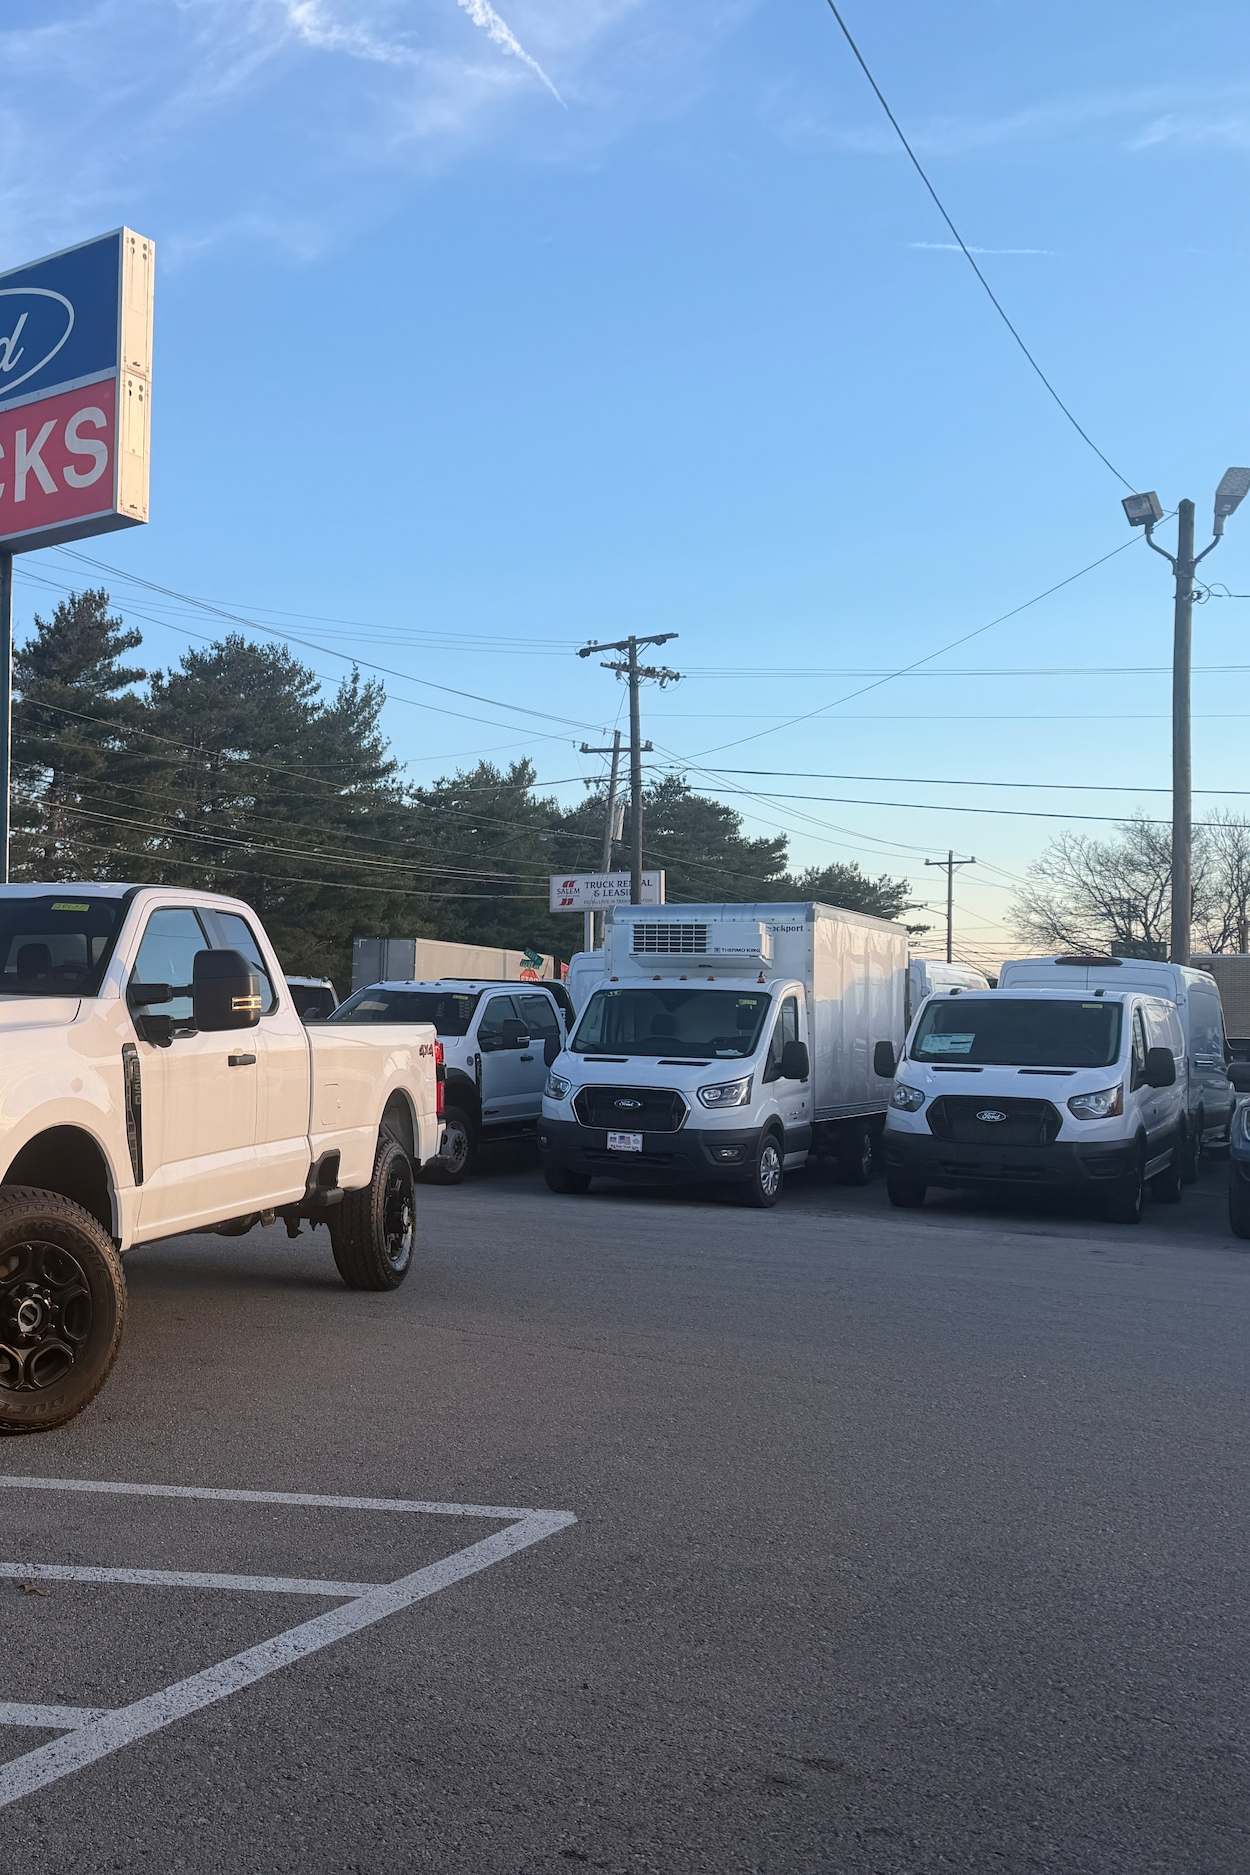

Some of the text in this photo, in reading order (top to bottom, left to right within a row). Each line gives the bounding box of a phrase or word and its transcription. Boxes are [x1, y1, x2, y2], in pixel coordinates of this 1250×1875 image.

[584, 879, 653, 889] TRUCK REAL
[556, 887, 580, 895] SALEM
[593, 888, 631, 897] & LEASI
